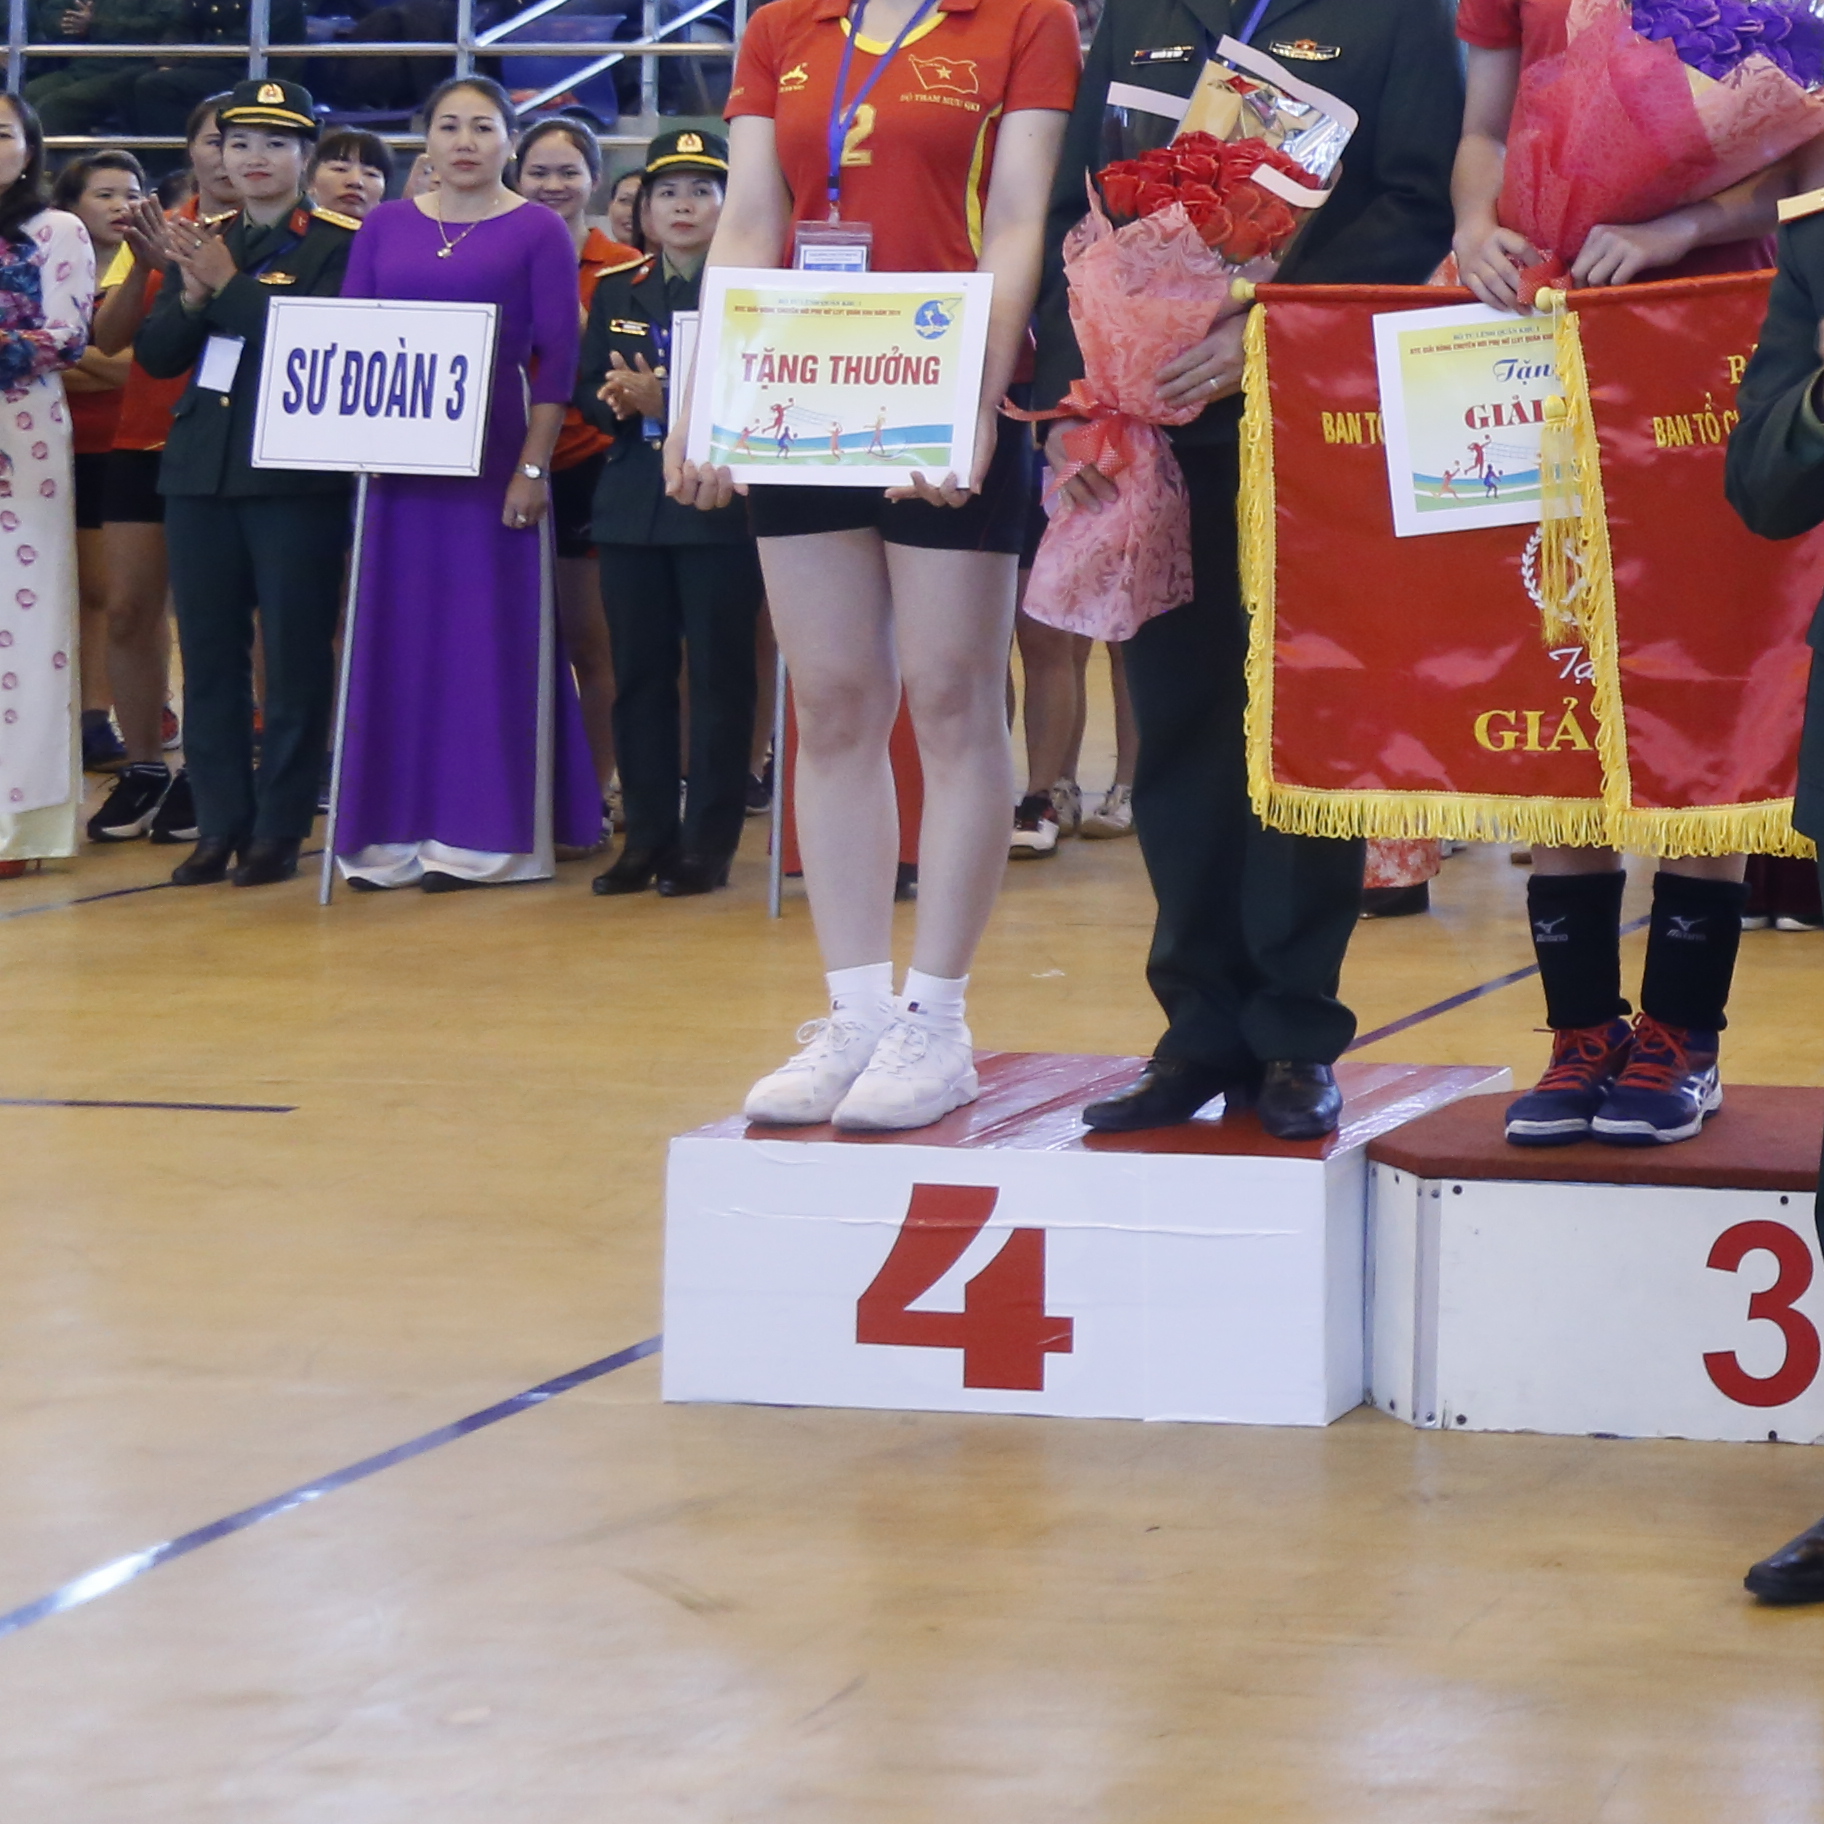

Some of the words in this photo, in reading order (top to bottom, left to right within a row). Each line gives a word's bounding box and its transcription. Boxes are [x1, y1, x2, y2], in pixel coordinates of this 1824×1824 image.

[840, 103, 877, 167] 2
[283, 343, 338, 415] SƯ
[339, 337, 438, 418] ĐOÀN
[446, 355, 468, 420] 3
[742, 347, 819, 390] TẶNG
[829, 346, 941, 385] THƯỞNG
[1493, 359, 1561, 385] Tặn
[1322, 413, 1361, 444] BAN
[1653, 415, 1694, 447] BAN
[1692, 392, 1721, 444] TỔ
[1474, 697, 1593, 751] GIẢ
[857, 1184, 1073, 1391] 4
[1703, 1221, 1820, 1407] 3
